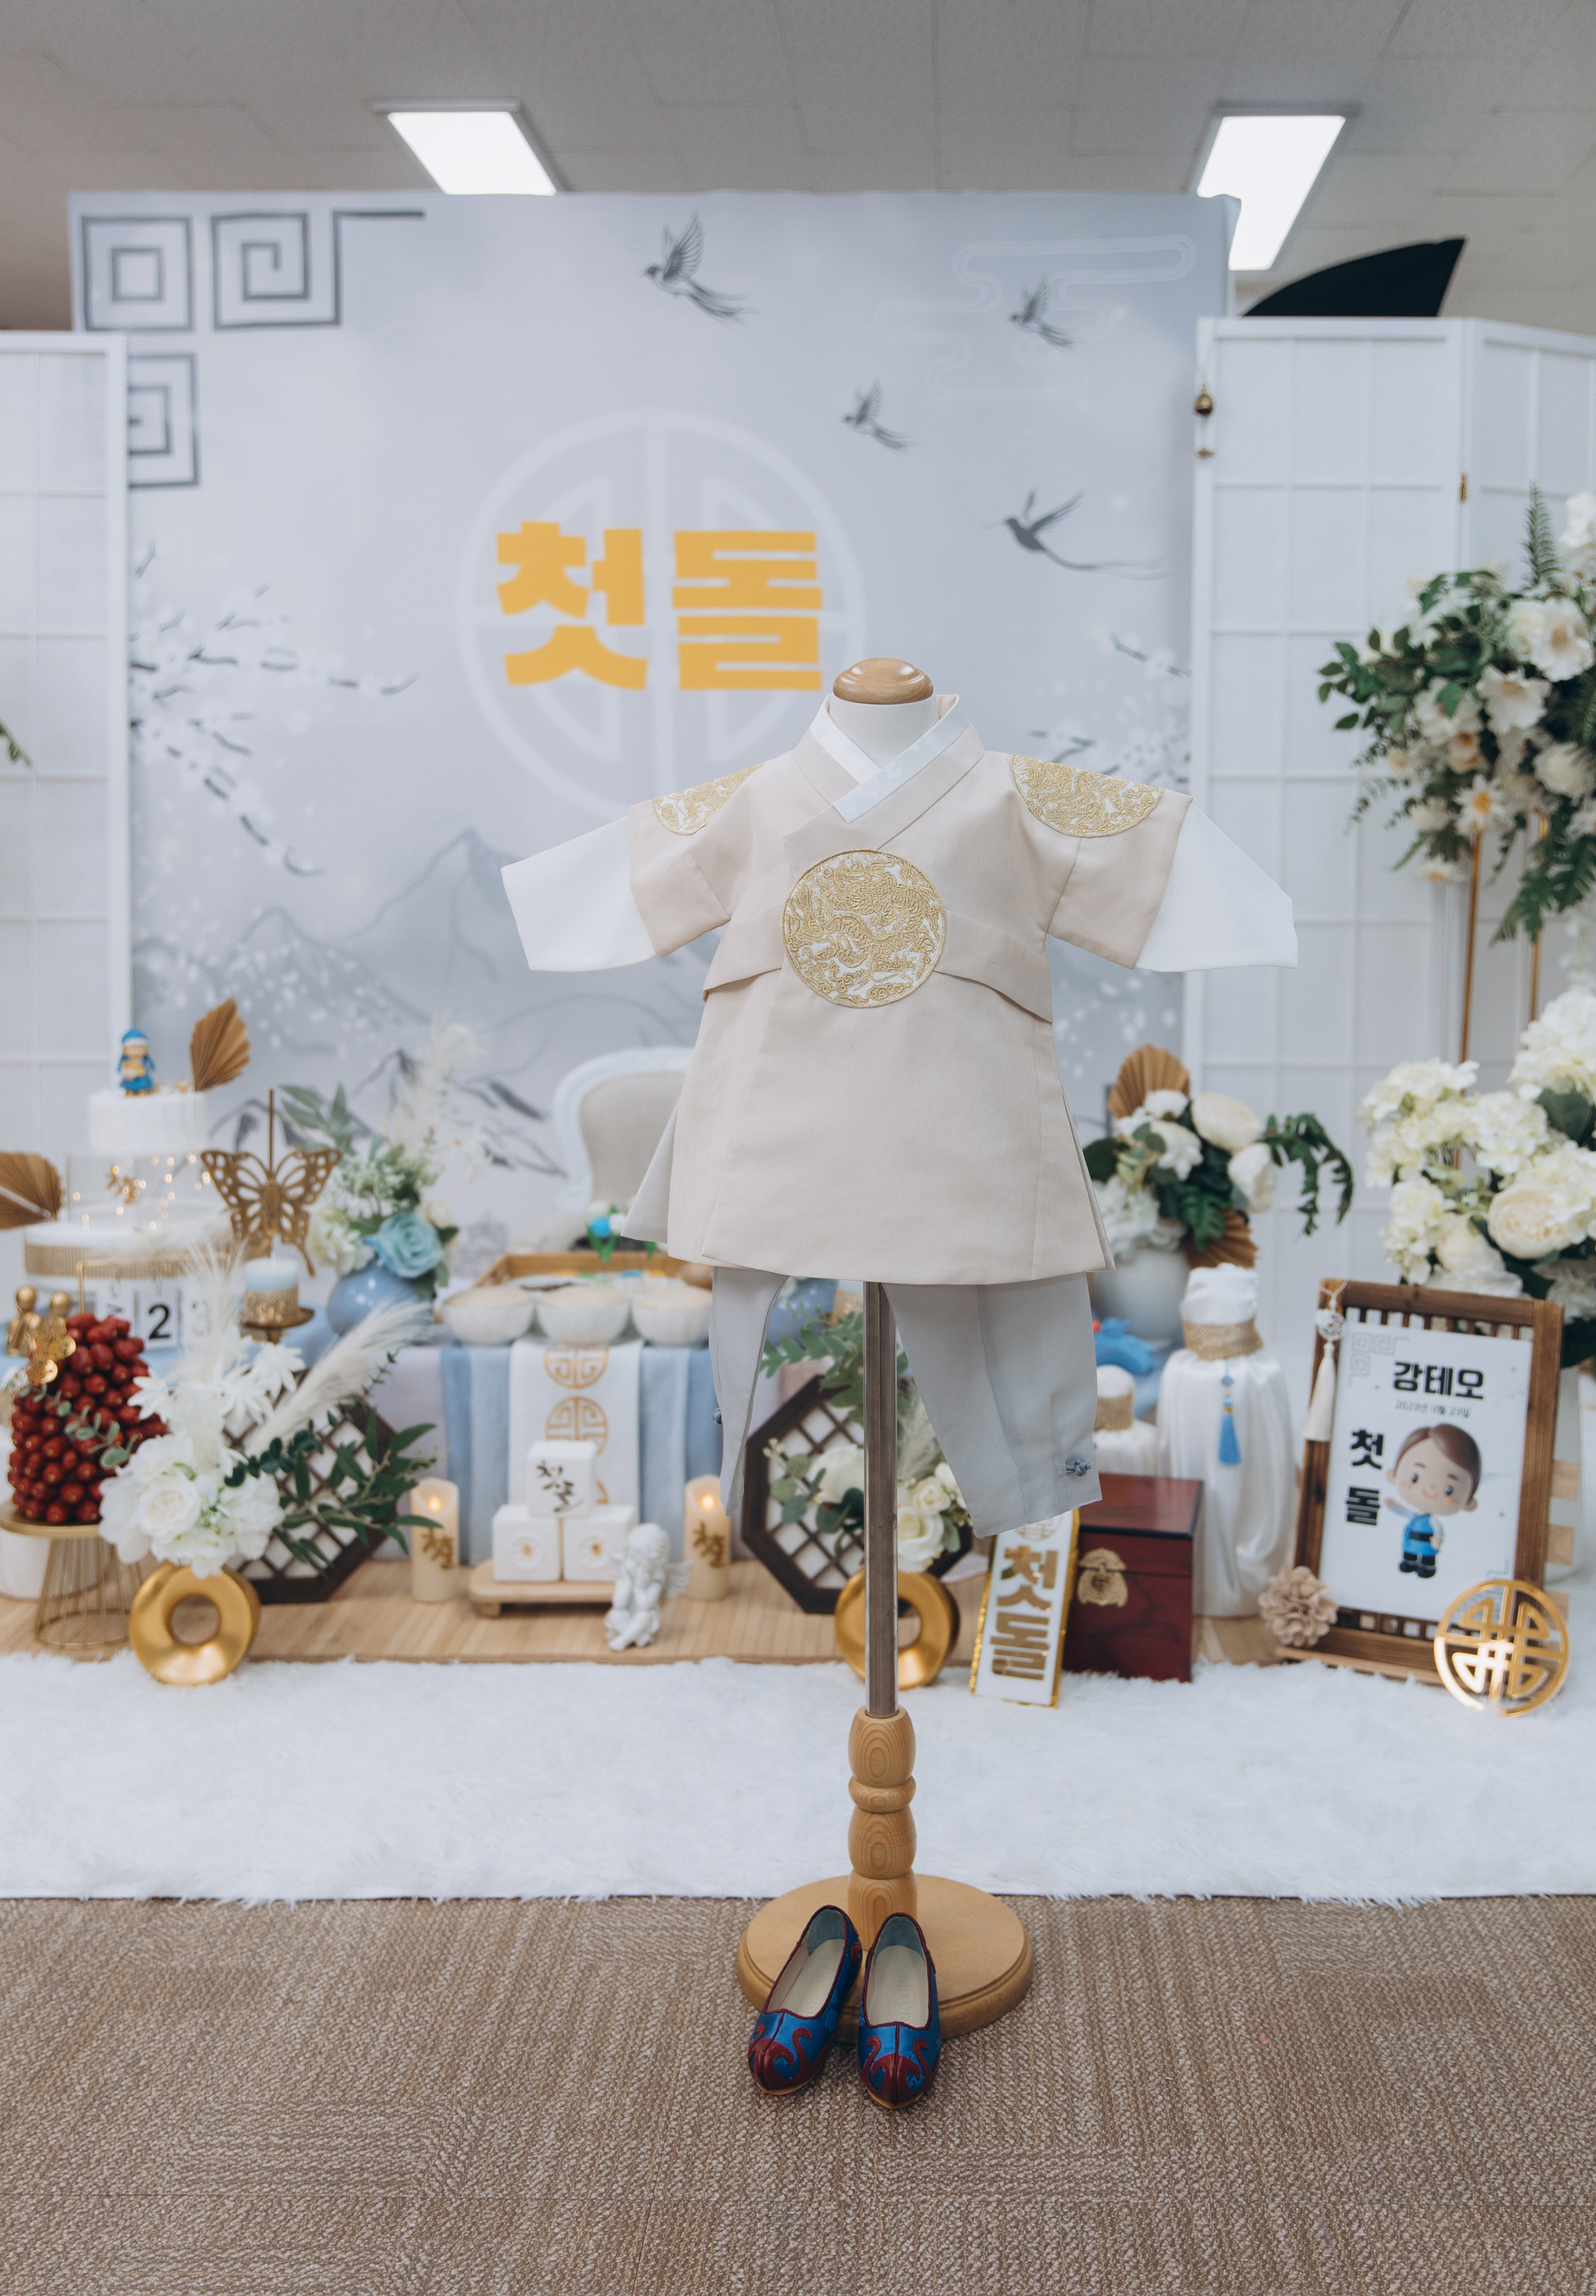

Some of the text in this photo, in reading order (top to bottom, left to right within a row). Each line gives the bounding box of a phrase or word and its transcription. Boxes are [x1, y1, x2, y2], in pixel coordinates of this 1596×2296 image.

[496, 519, 822, 692] 첫돌
[148, 1303, 172, 1340] 2
[990, 1545, 1059, 1681] 첫돌
